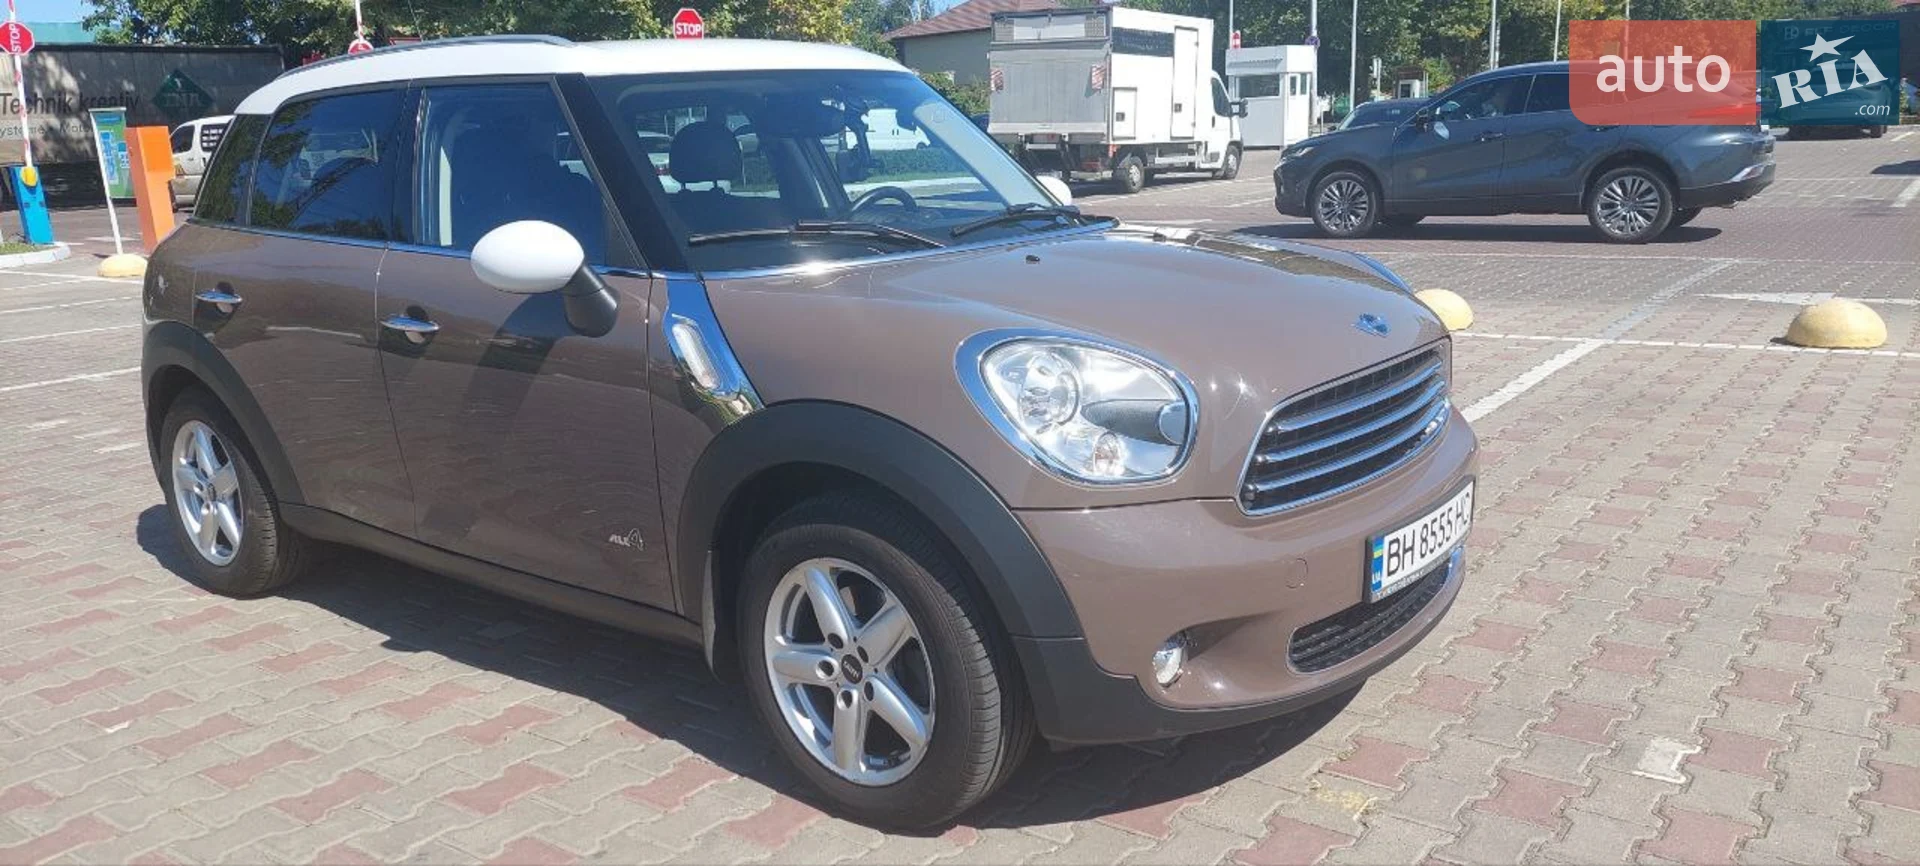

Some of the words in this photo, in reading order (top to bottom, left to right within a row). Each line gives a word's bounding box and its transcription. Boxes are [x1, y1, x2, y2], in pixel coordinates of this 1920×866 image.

[9, 23, 22, 52] STOP
[676, 23, 701, 35] STOP
[1387, 530, 1415, 577] BH
[1420, 507, 1453, 559] 8555
